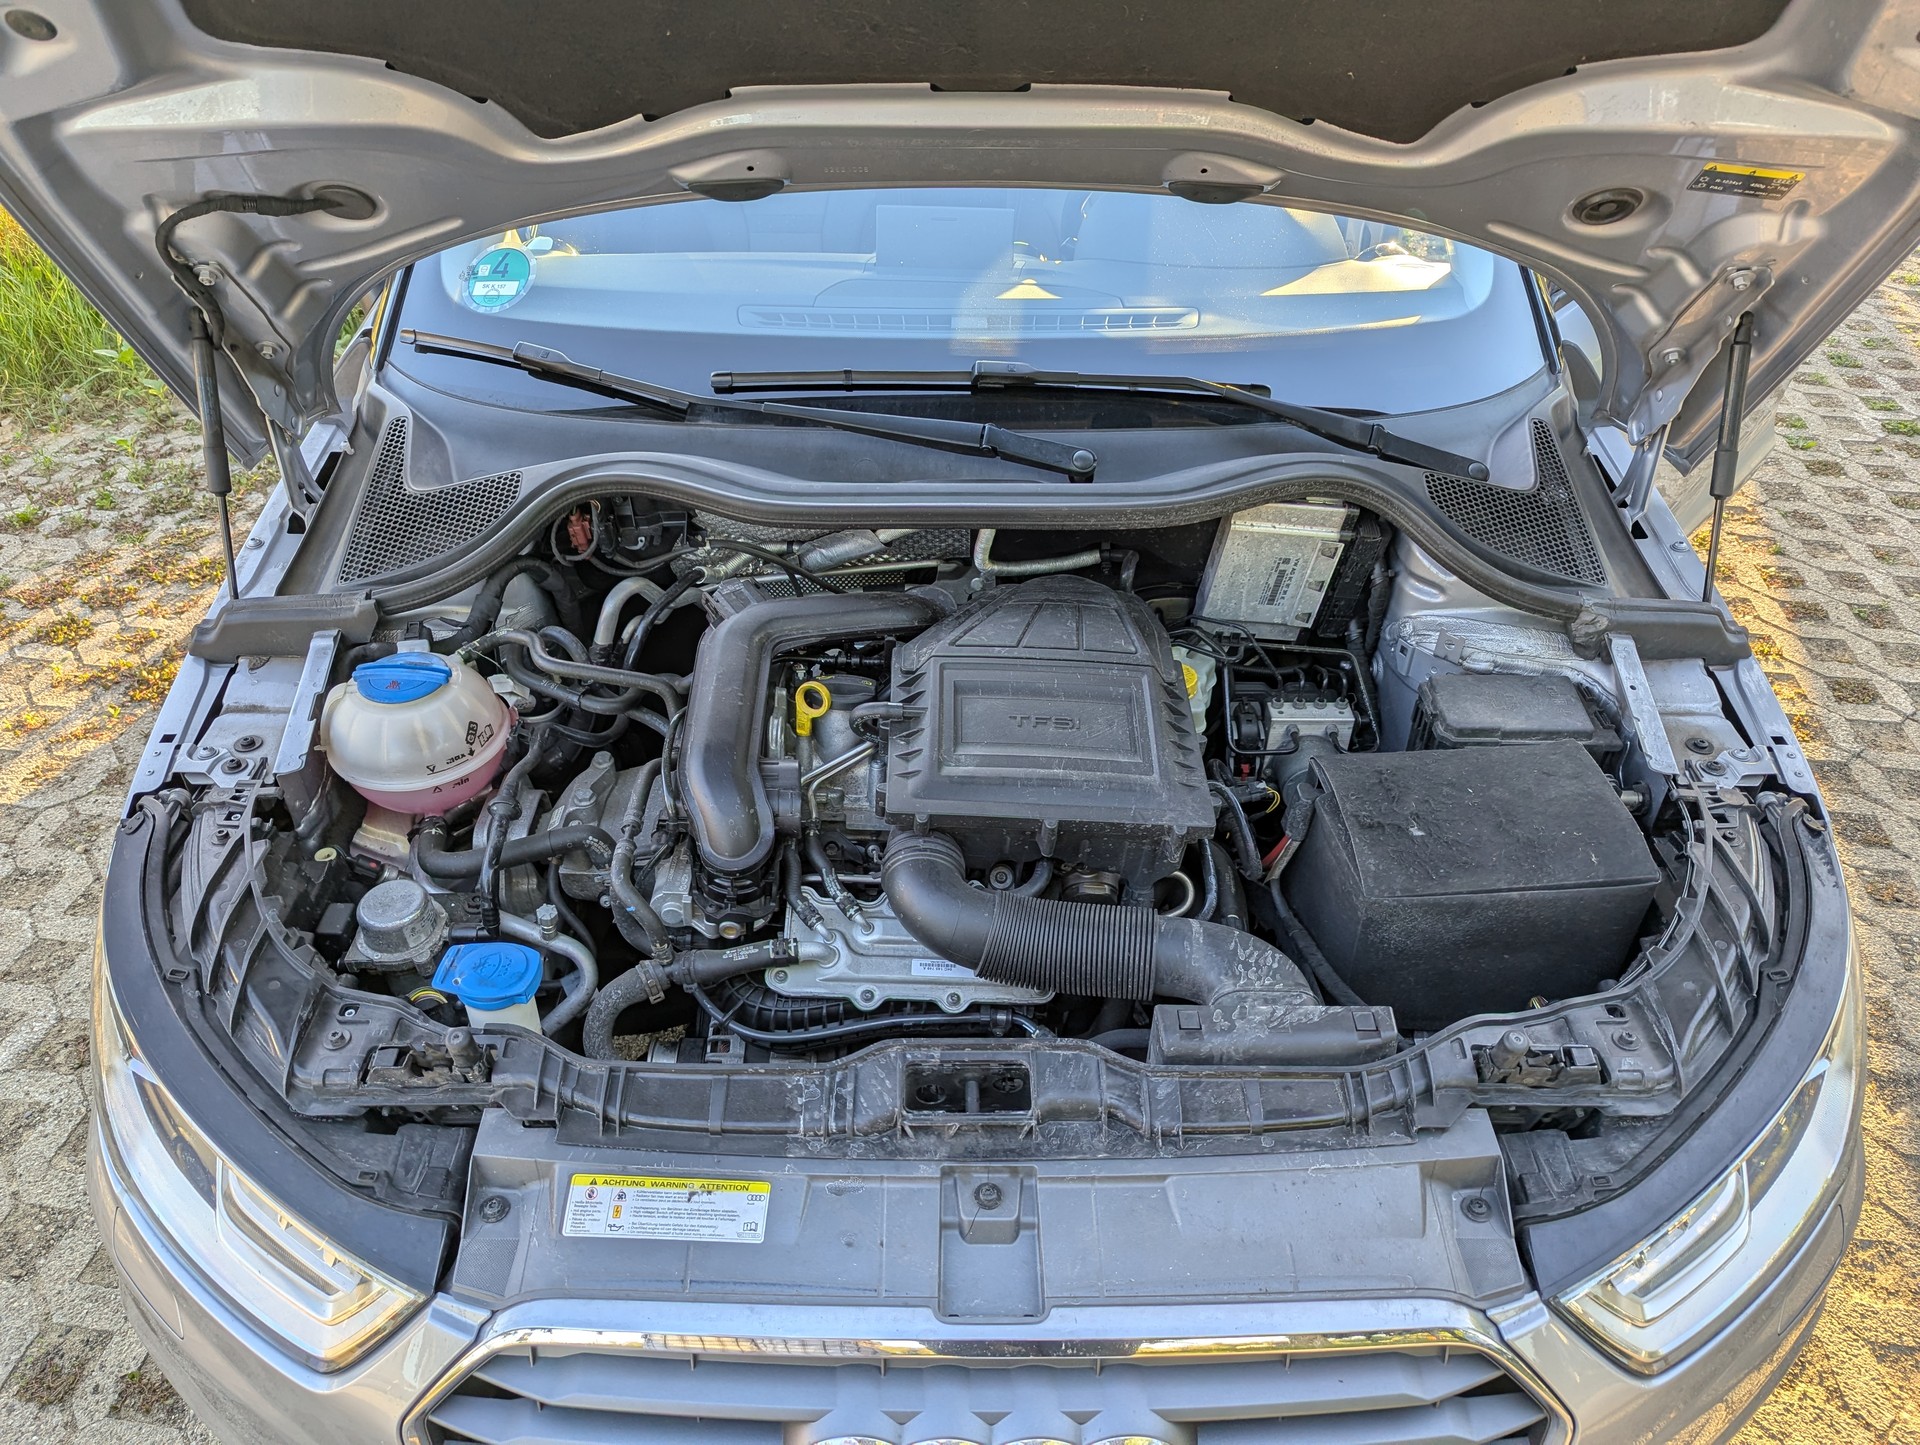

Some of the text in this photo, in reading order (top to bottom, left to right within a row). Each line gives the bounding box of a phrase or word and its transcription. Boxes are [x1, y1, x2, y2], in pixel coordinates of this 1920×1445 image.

[492, 252, 510, 278] 4
[467, 723, 477, 743] G13
[602, 1179, 750, 1191] ACHTUNG WARNING ATTENTION
